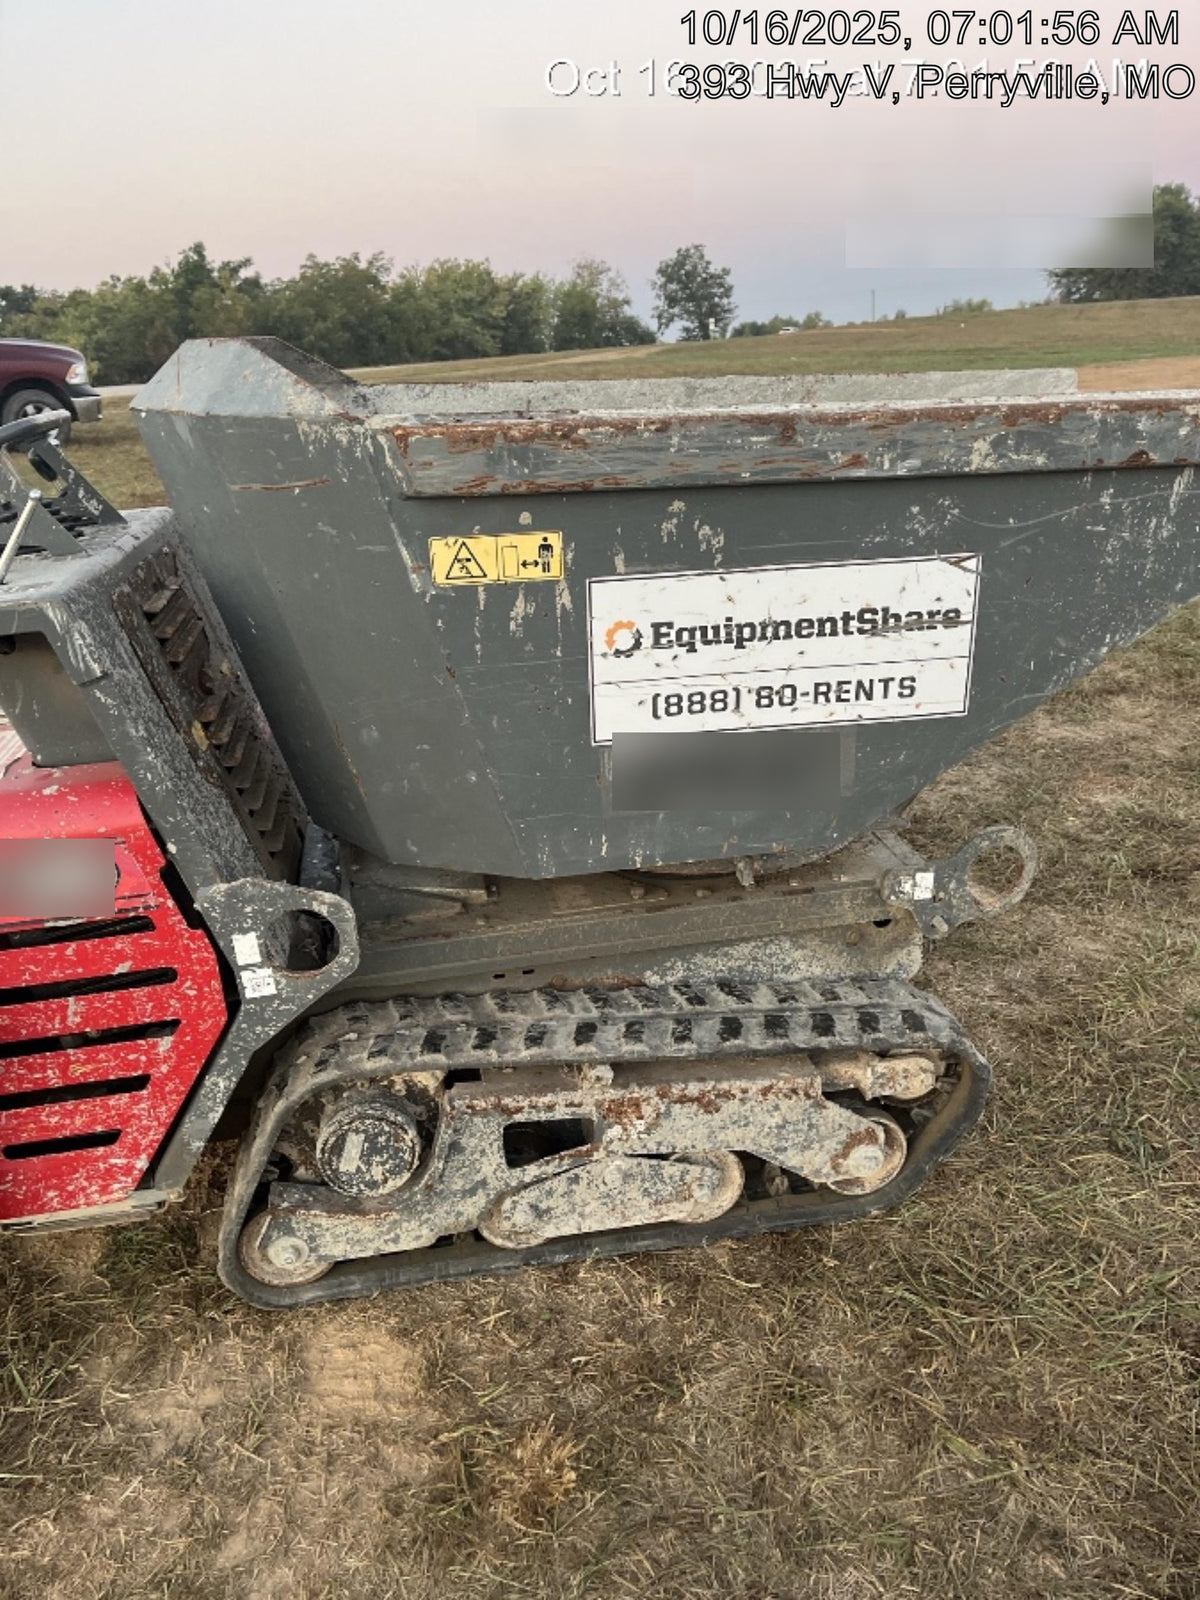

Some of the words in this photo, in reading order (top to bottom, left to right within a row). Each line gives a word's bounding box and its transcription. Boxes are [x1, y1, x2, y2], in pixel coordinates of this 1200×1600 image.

[650, 606, 962, 653] EquipmentShare
[652, 687, 742, 720] (888)
[755, 675, 918, 708] 80-RENTS
